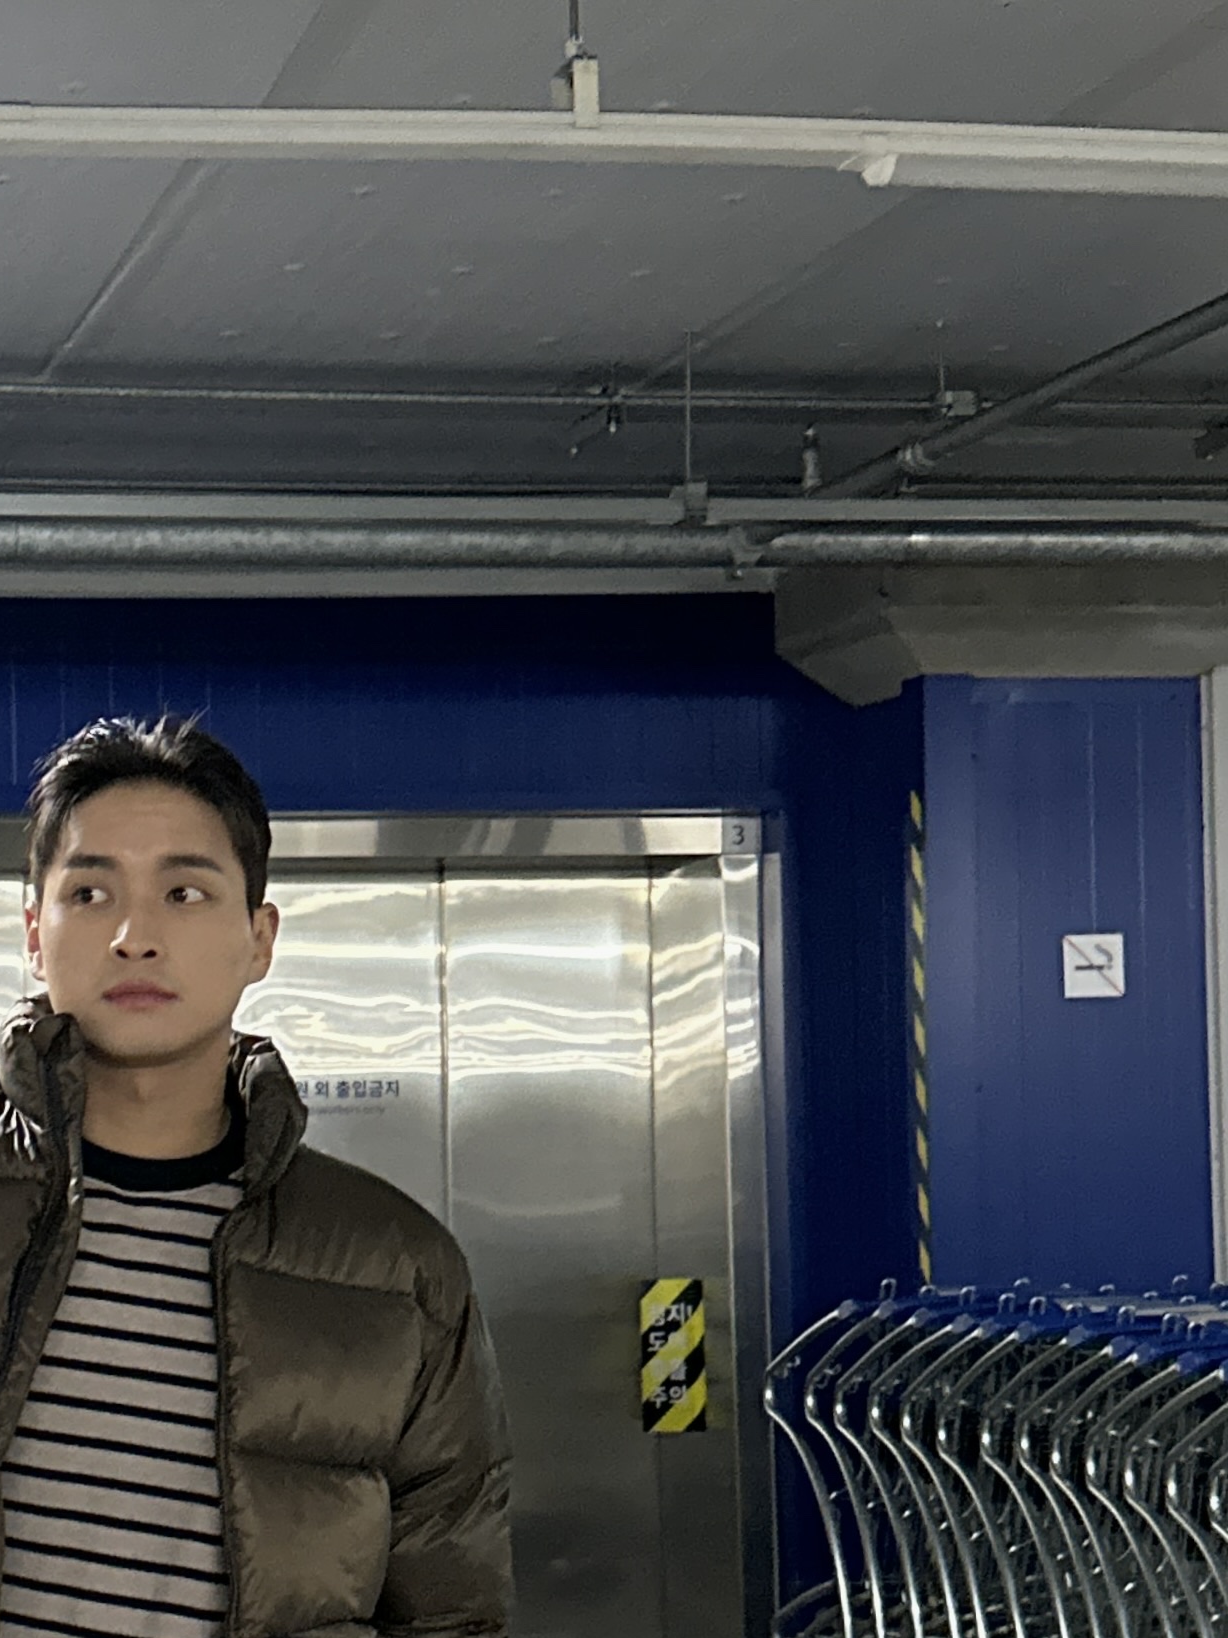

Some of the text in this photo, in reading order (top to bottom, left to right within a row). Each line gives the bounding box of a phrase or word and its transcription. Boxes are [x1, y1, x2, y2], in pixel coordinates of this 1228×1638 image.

[732, 825, 745, 846] 3
[315, 1080, 329, 1098] 외
[335, 1079, 400, 1098] 출입금지
